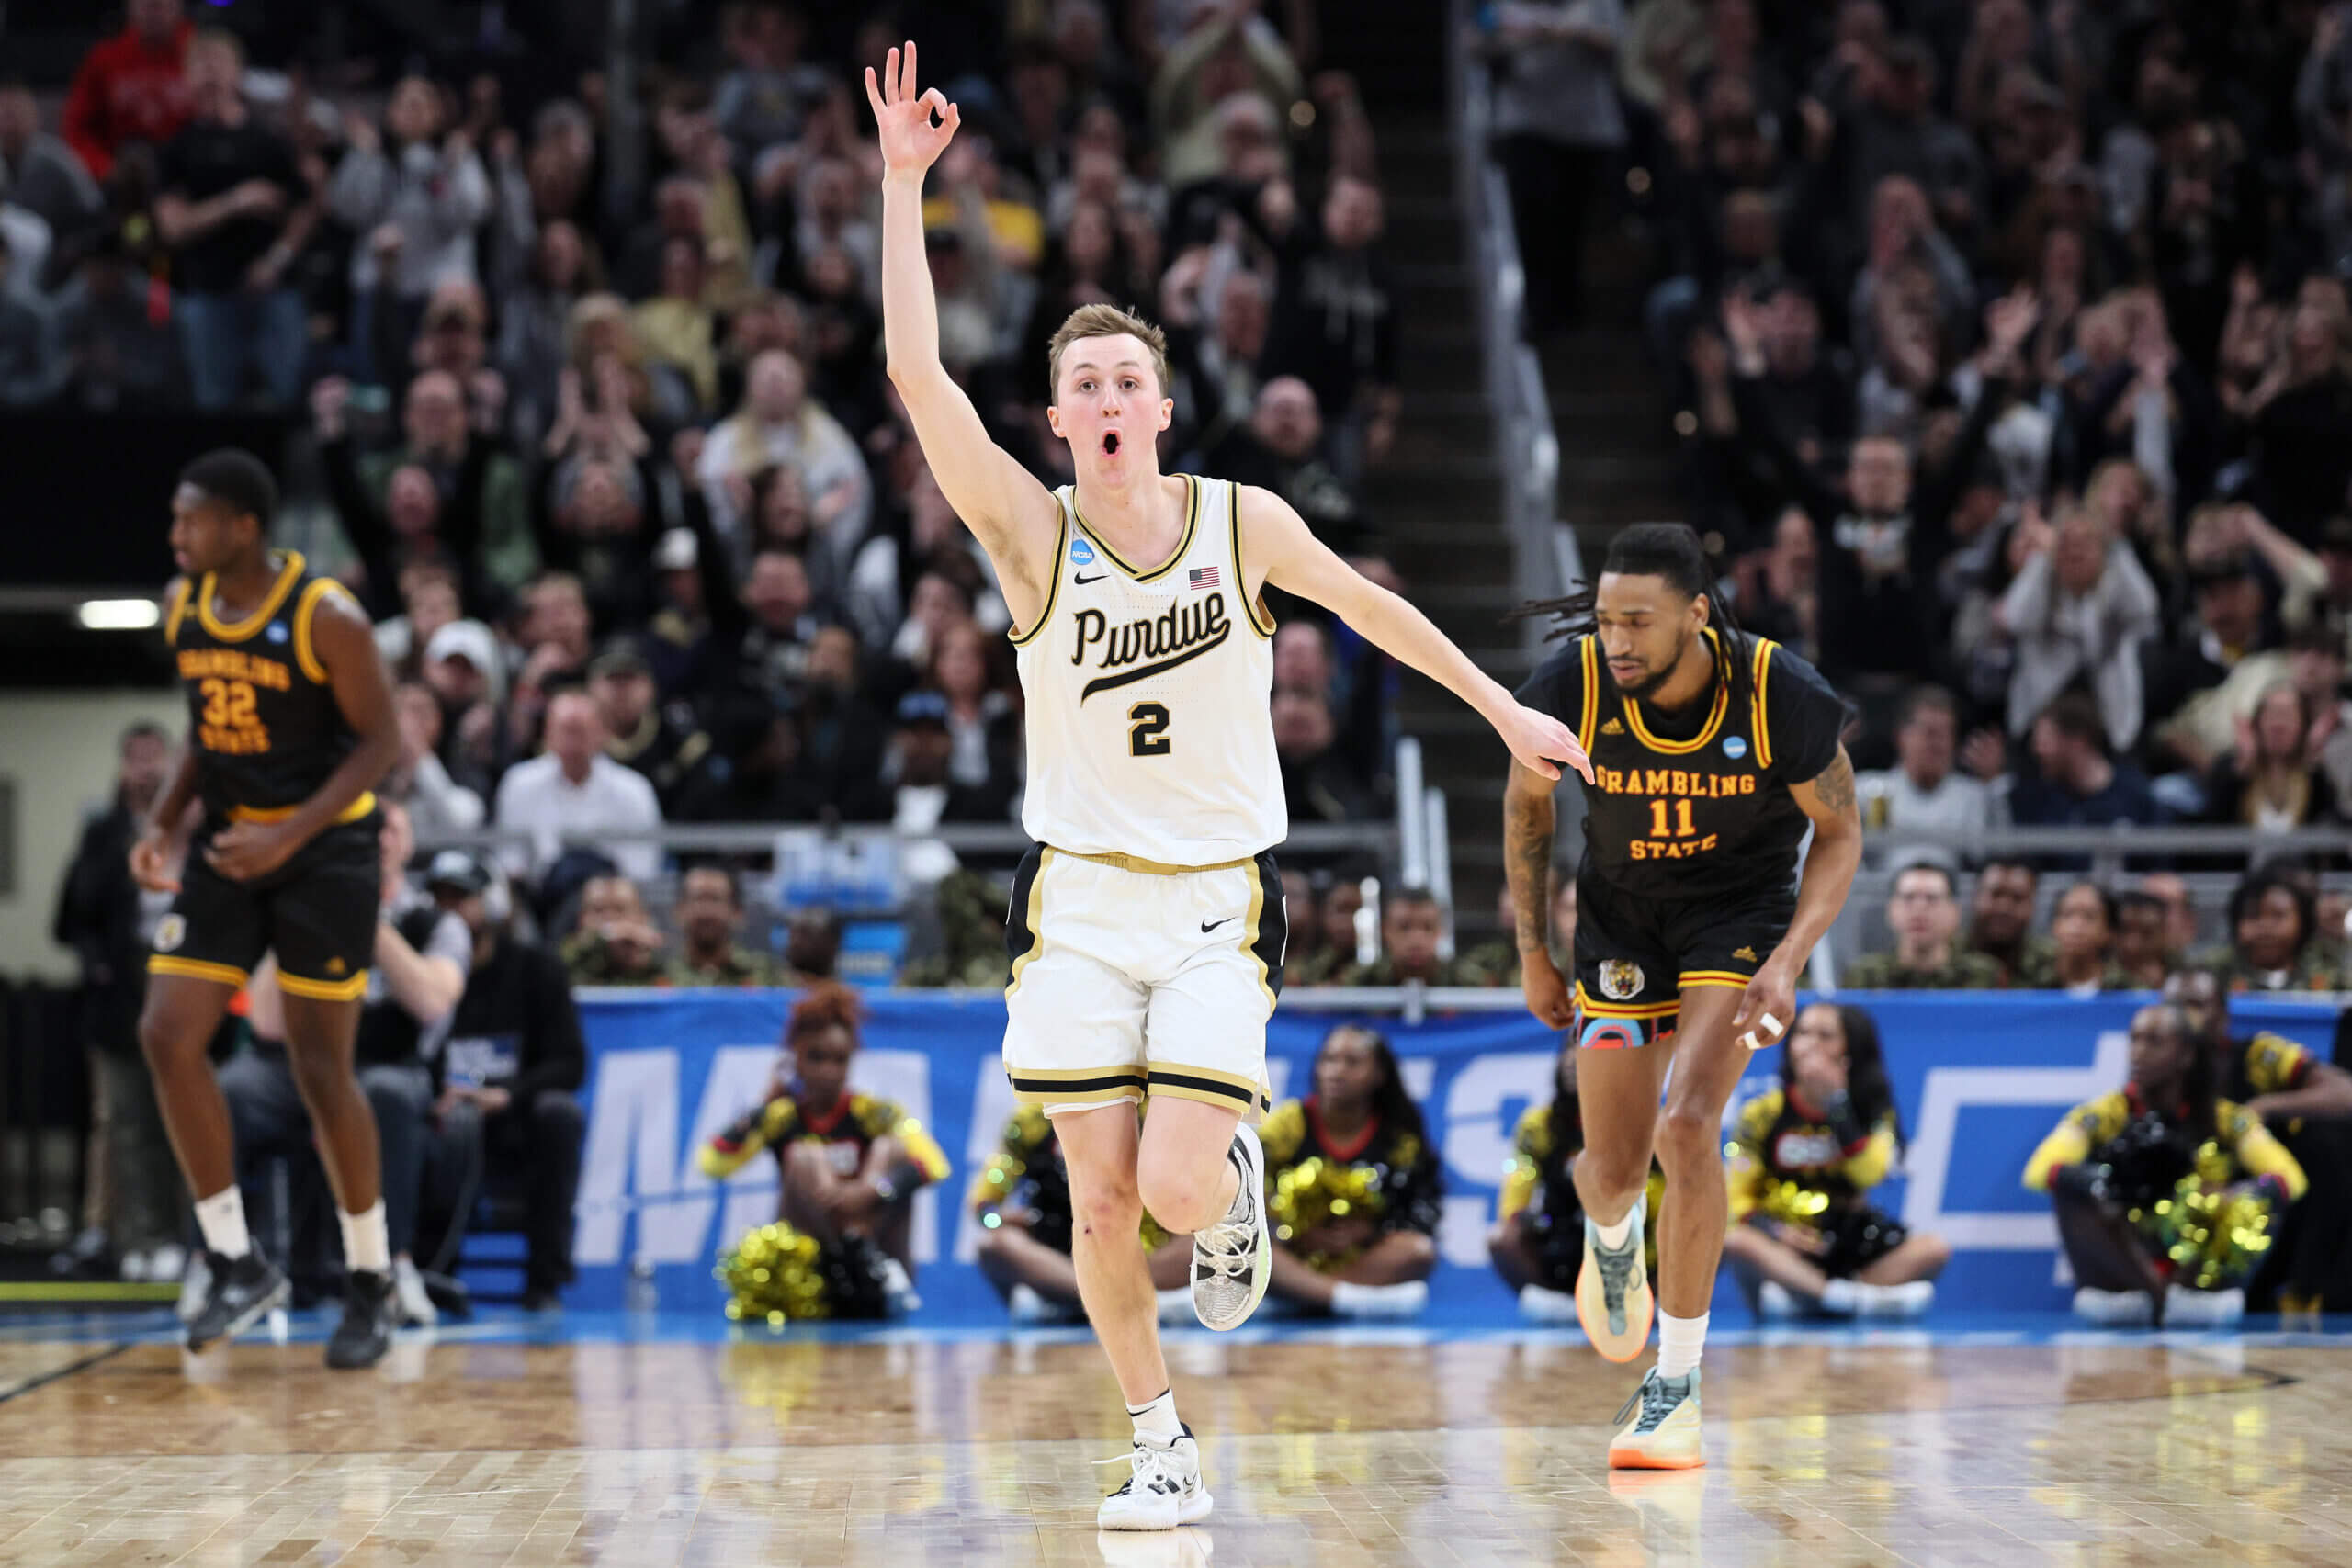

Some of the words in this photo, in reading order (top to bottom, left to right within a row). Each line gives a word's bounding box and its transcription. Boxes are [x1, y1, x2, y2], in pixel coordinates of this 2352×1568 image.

[1071, 550, 1093, 559] NCAA
[1071, 592, 1231, 670] Purdue
[200, 678, 259, 728] 32
[1127, 700, 1171, 757] 2
[1595, 764, 1756, 799] GRAMBLING
[1649, 798, 1697, 838] 11
[1629, 832, 1718, 861] STATE
